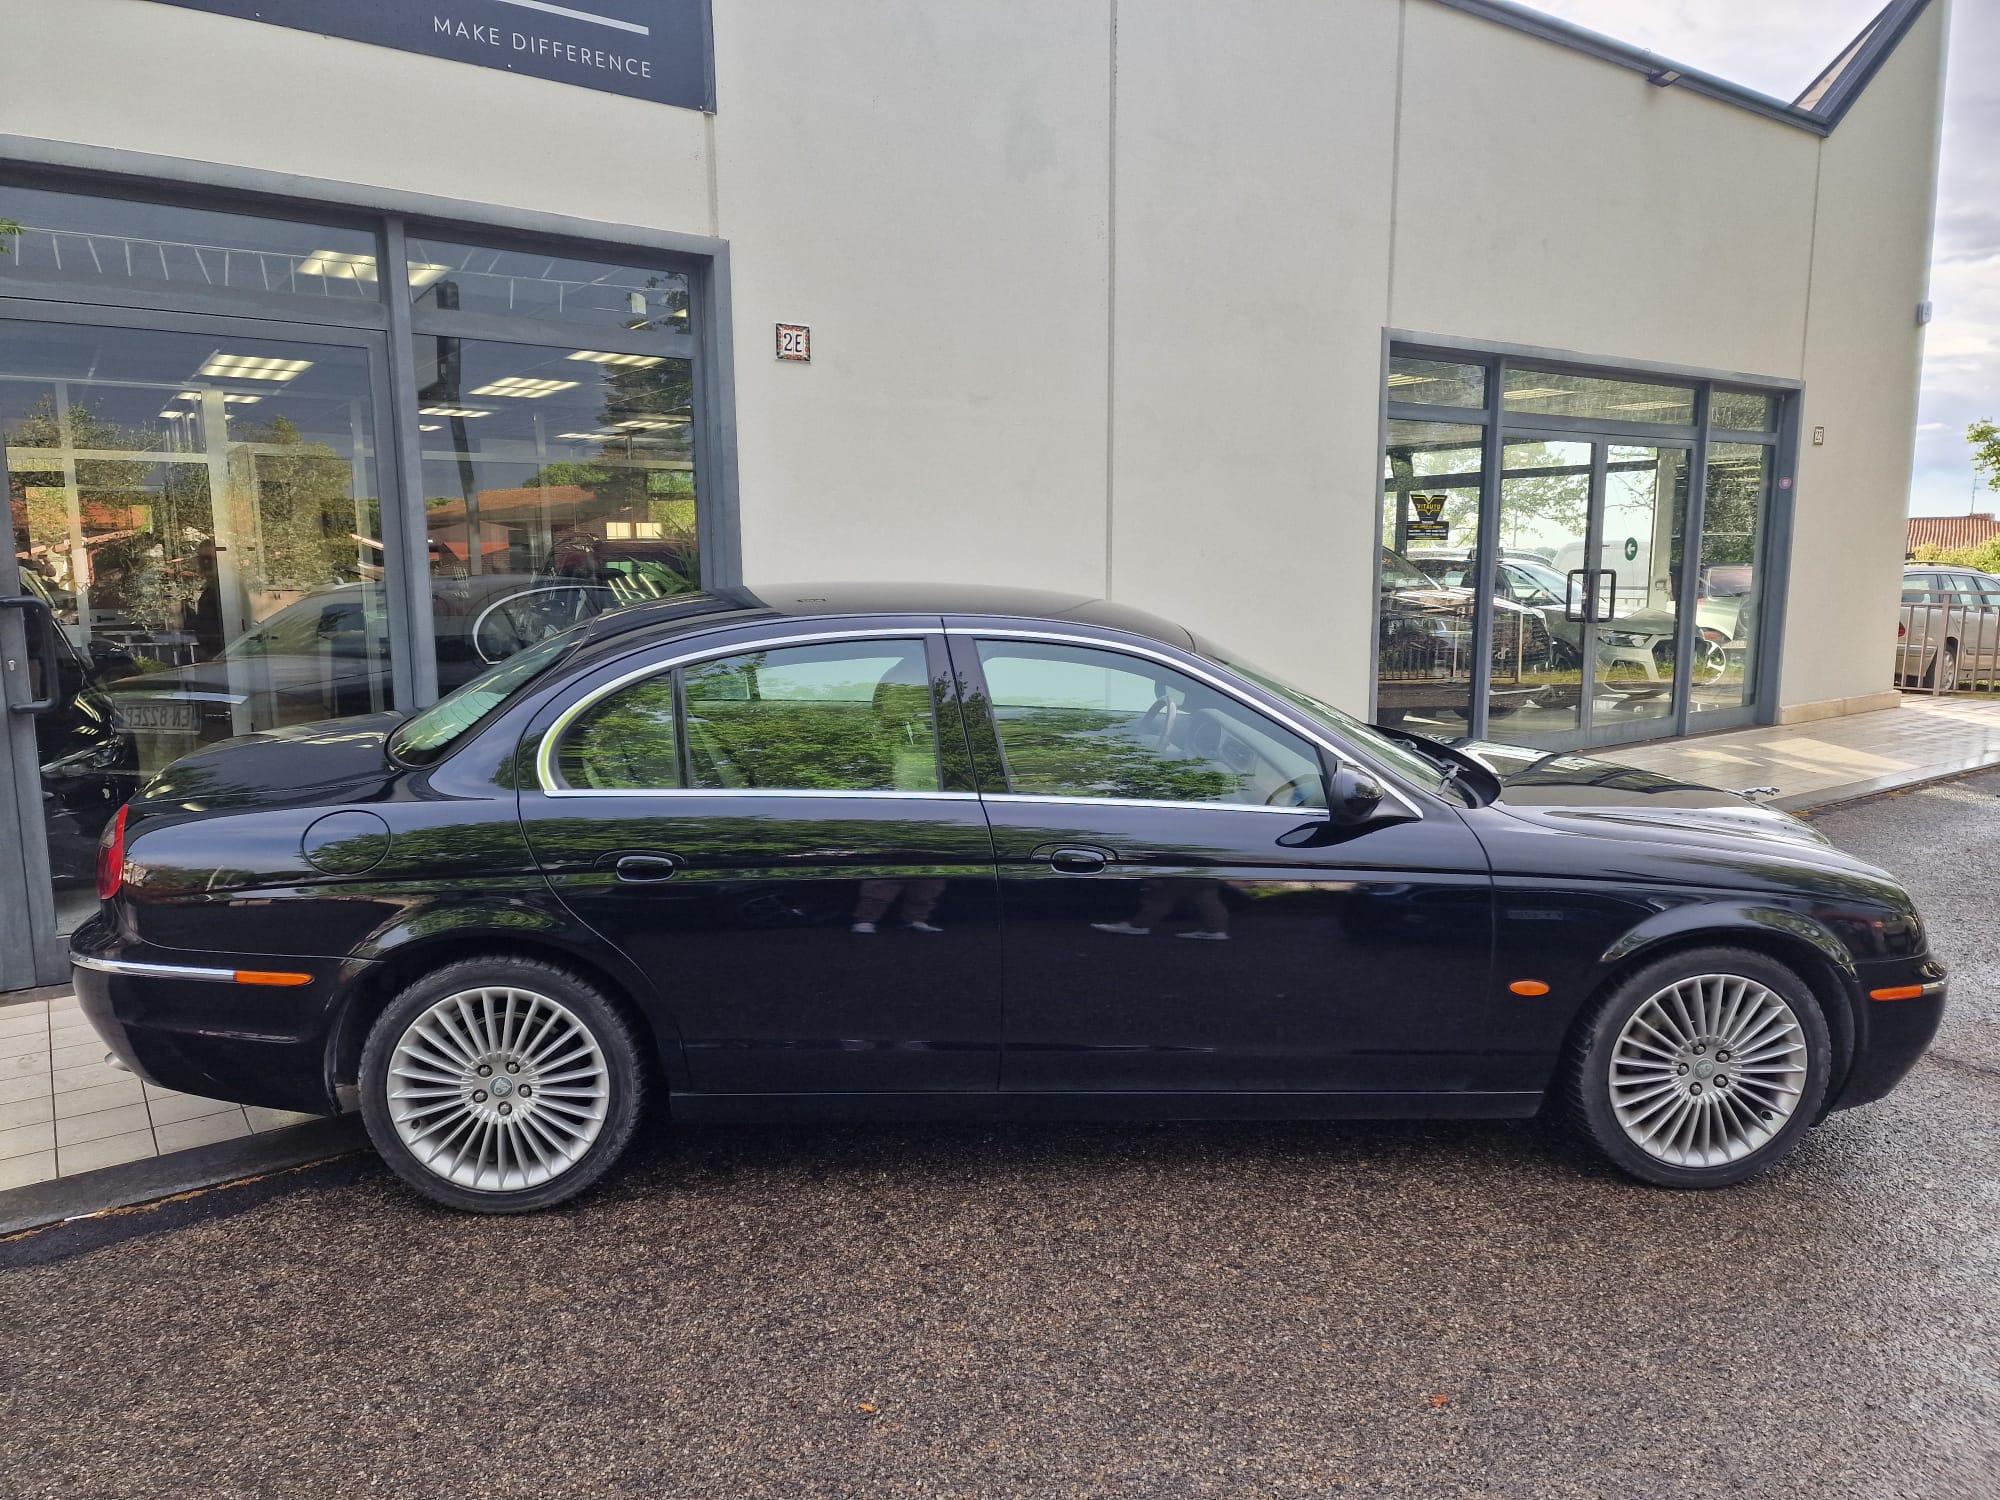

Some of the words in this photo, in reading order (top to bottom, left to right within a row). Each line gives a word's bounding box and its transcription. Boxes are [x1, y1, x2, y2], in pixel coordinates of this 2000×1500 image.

[433, 15, 501, 46] MAKE
[512, 32, 651, 78] DIFFERENCE
[783, 332, 802, 353] 2E
